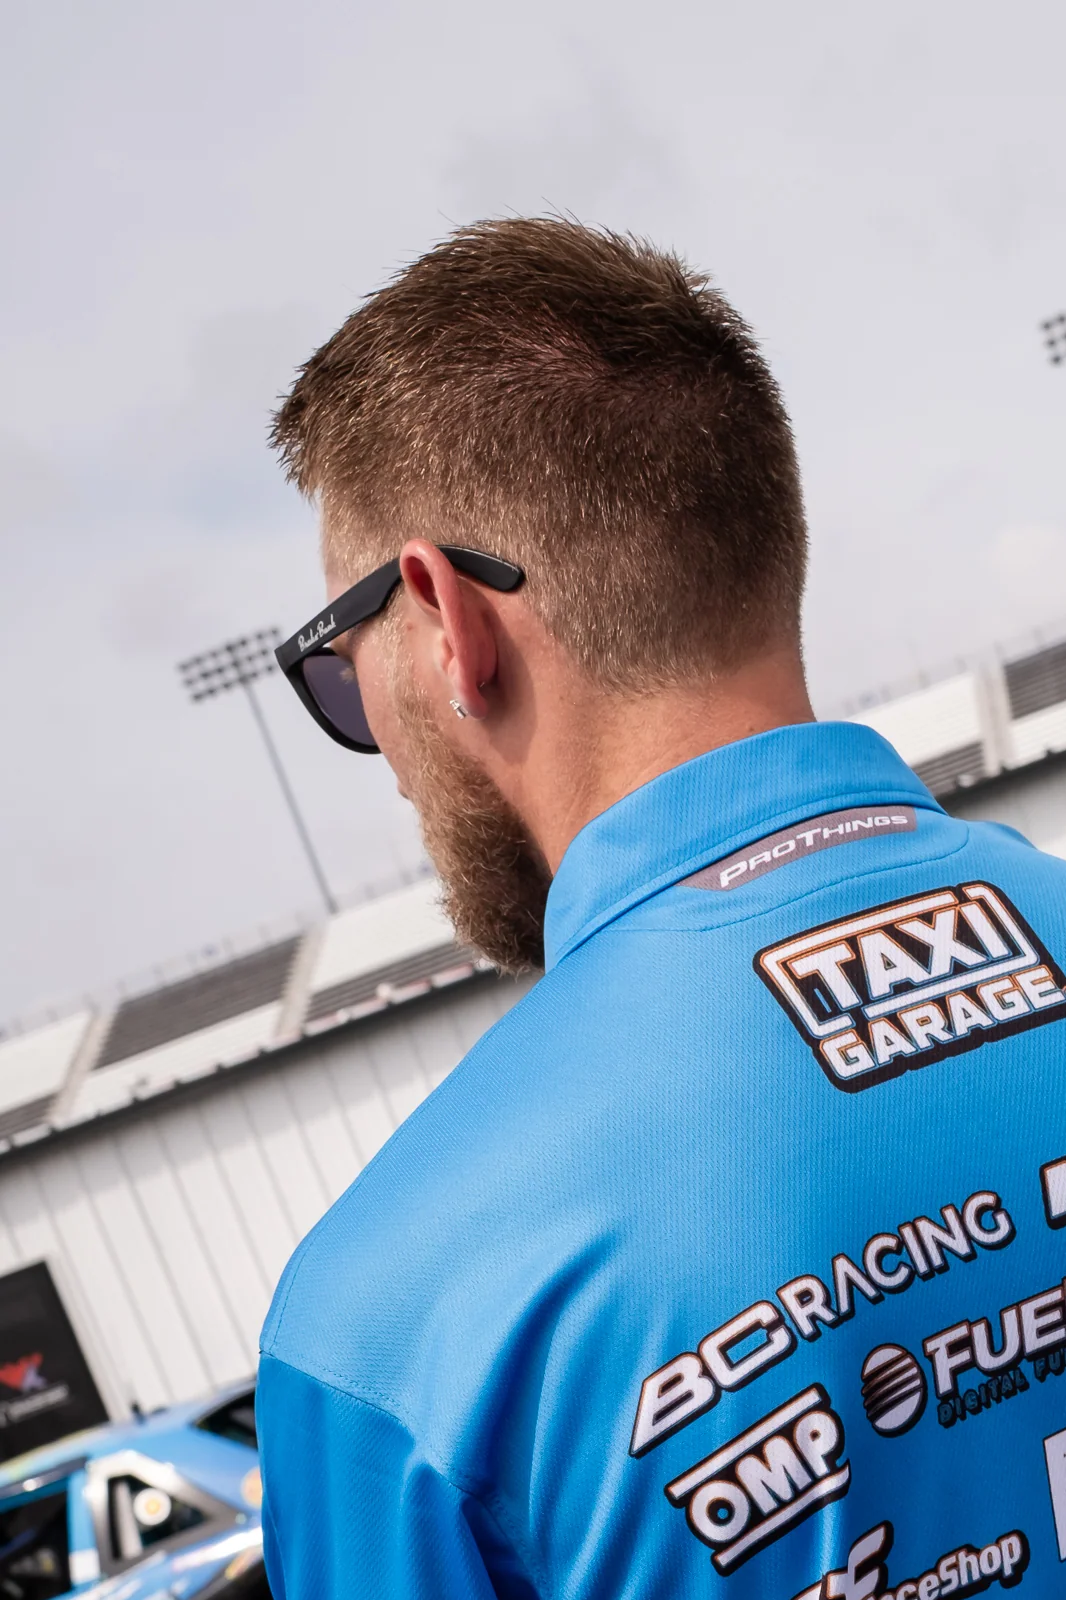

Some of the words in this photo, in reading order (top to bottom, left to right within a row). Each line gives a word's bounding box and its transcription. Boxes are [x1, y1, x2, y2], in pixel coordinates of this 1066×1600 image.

[786, 901, 1013, 1011] TAXI
[937, 1368, 1028, 1425] DIGITAL
[688, 1409, 841, 1543] OMP
